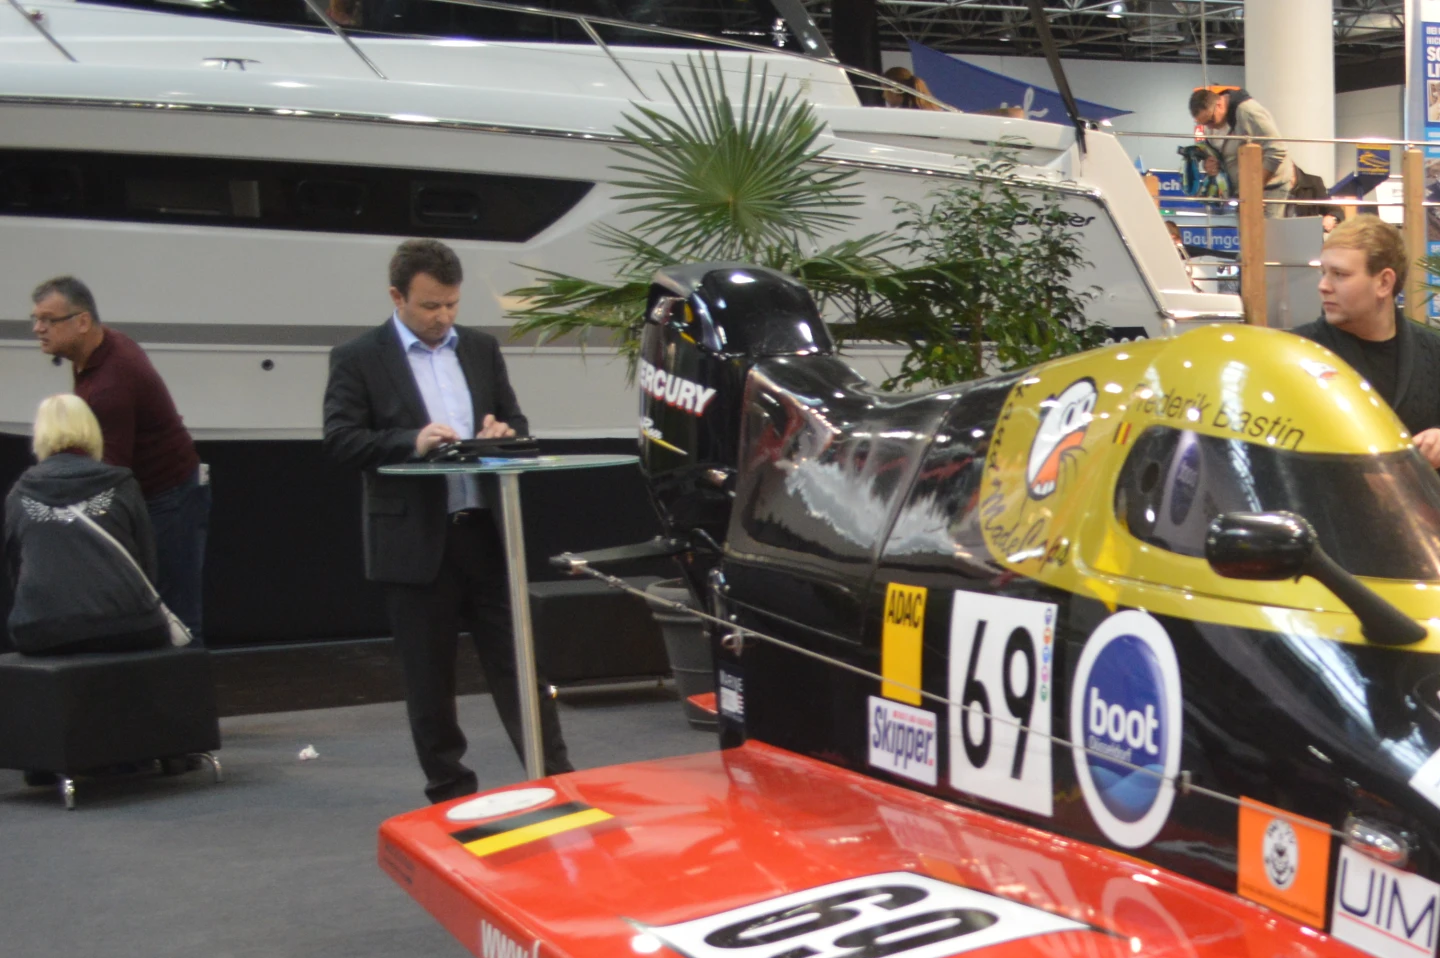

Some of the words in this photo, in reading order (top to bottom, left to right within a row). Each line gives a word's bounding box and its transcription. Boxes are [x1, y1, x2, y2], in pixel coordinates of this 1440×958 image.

[1213, 401, 1305, 450] Bastin
[888, 588, 923, 628] ADAC
[961, 619, 1036, 780] 69
[1090, 686, 1159, 756] boot
[1339, 856, 1437, 949] UIM
